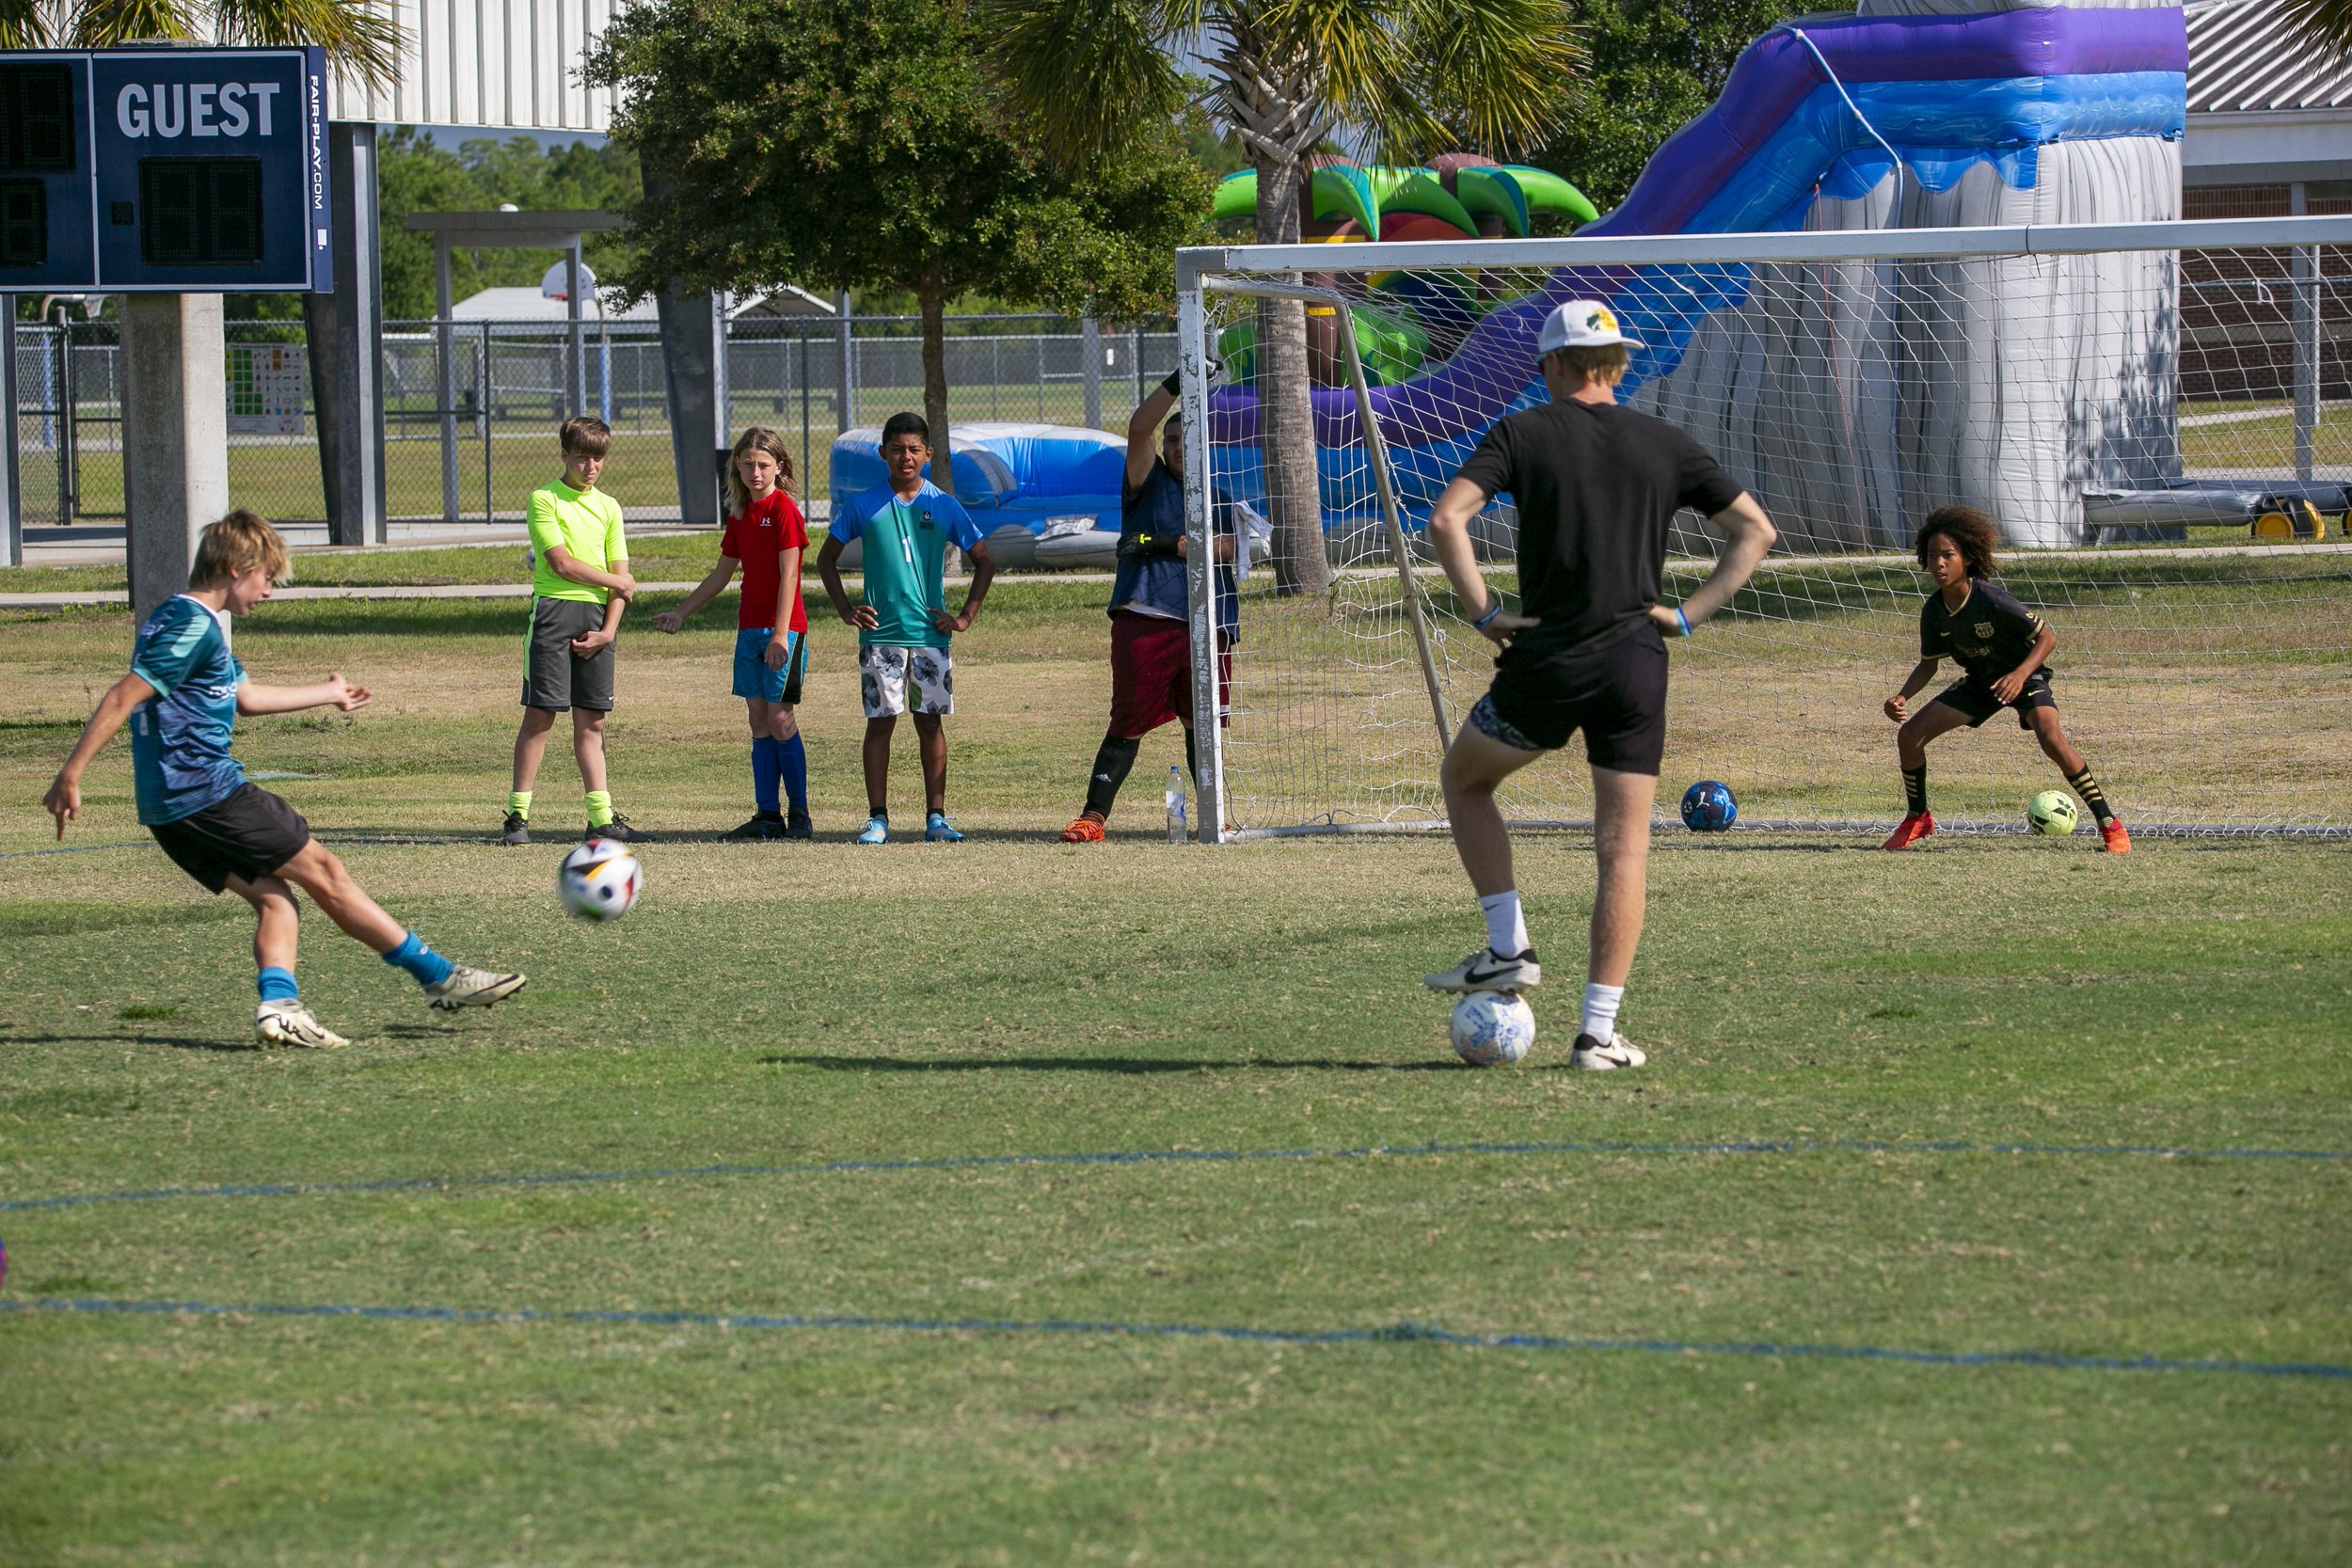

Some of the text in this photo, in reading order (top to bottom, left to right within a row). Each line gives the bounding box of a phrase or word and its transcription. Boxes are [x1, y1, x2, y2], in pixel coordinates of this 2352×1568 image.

[117, 82, 280, 138] GUEST
[310, 75, 323, 210] FAIR-PLAY.COM
[902, 535, 912, 562] 1
